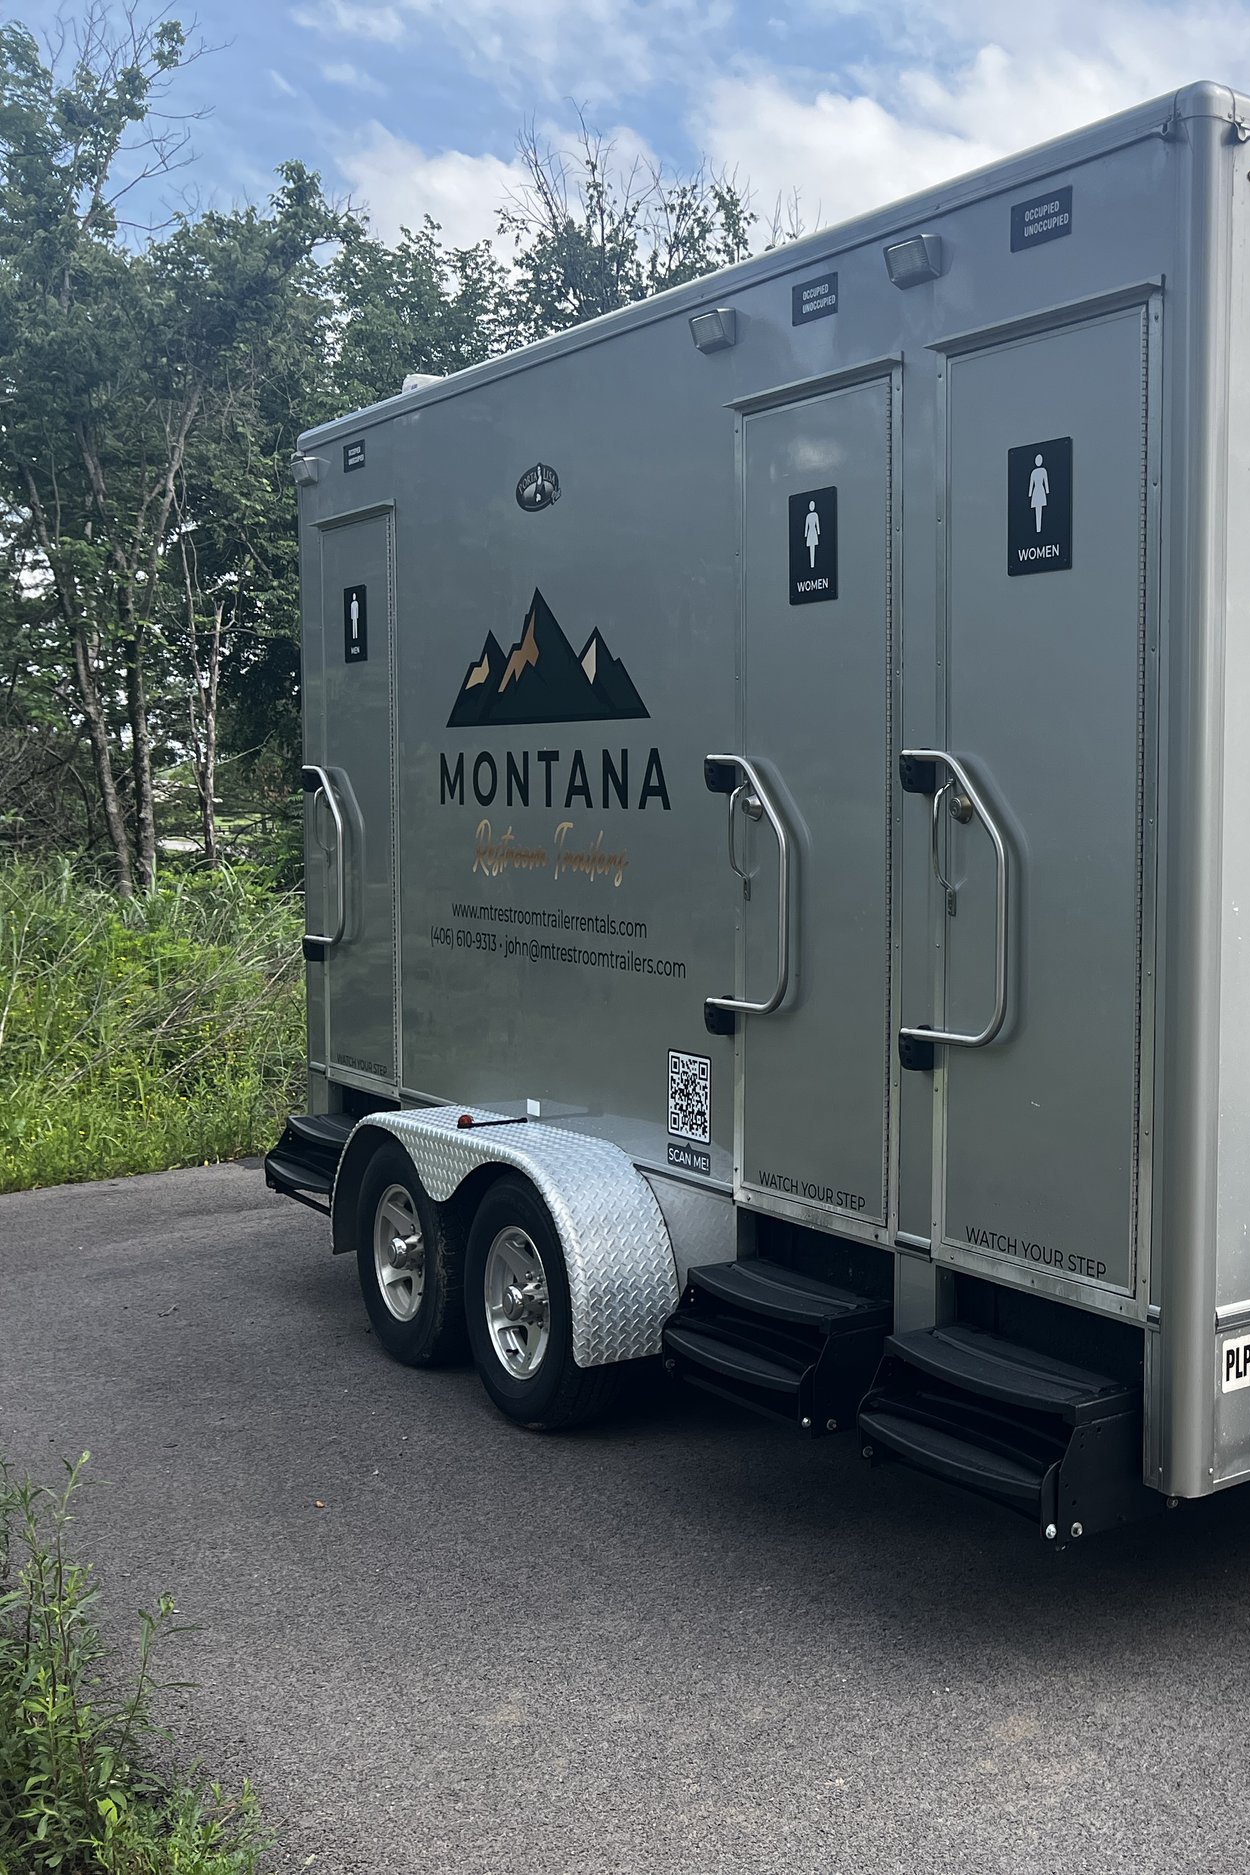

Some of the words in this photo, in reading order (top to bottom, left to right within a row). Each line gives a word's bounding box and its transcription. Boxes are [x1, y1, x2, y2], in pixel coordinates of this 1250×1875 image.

[1024, 200, 1060, 222] OCCUPIED
[1024, 212, 1069, 237] UNOCCUPIED
[802, 283, 829, 301] OCCUPIED
[802, 294, 836, 314] UNOCCUPIED
[1017, 543, 1060, 562] WOMEN
[796, 577, 829, 593] WOMEN
[440, 748, 671, 810] MONTANA
[472, 818, 549, 877] Restroom
[553, 821, 630, 888] Trailers
[451, 902, 648, 940] www.mtrestroomtrailerrentals.com
[430, 925, 455, 951] (406)
[456, 928, 498, 953] 610-9313
[503, 934, 687, 980] john@mtrestroomtrailers.com
[668, 1147, 692, 1166] SCAN
[693, 1154, 710, 1172] ME!
[759, 1169, 799, 1195] WATCH
[801, 1181, 834, 1204] YOUR
[836, 1190, 866, 1212] STEP
[965, 1225, 1017, 1256] WATCH
[1021, 1239, 1064, 1270] YOUR
[1067, 1253, 1107, 1279] STEP
